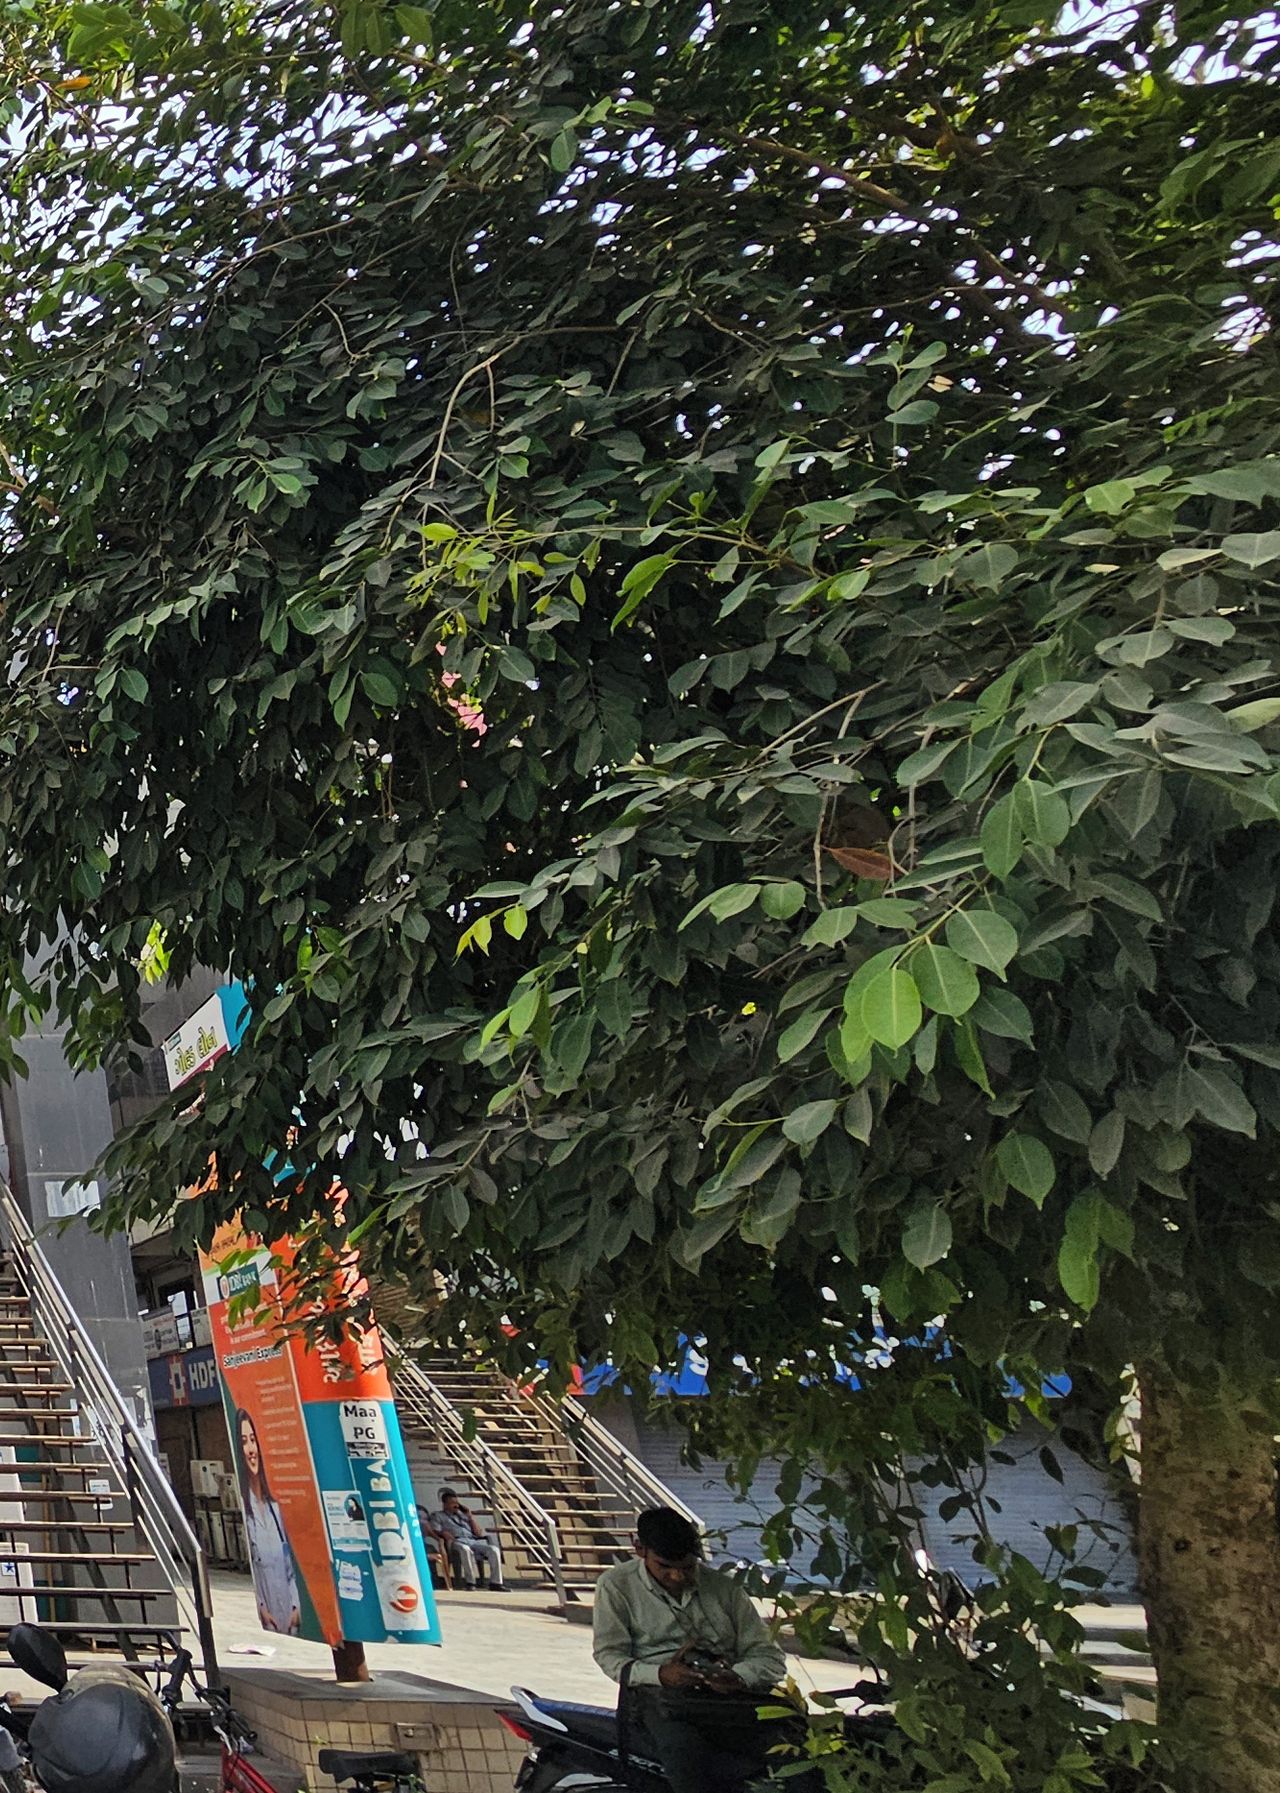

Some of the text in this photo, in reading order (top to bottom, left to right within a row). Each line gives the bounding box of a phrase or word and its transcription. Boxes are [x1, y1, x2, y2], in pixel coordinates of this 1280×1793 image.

[188, 1359, 216, 1391] HDF
[343, 1404, 377, 1418] Maa
[353, 1426, 376, 1440] PG
